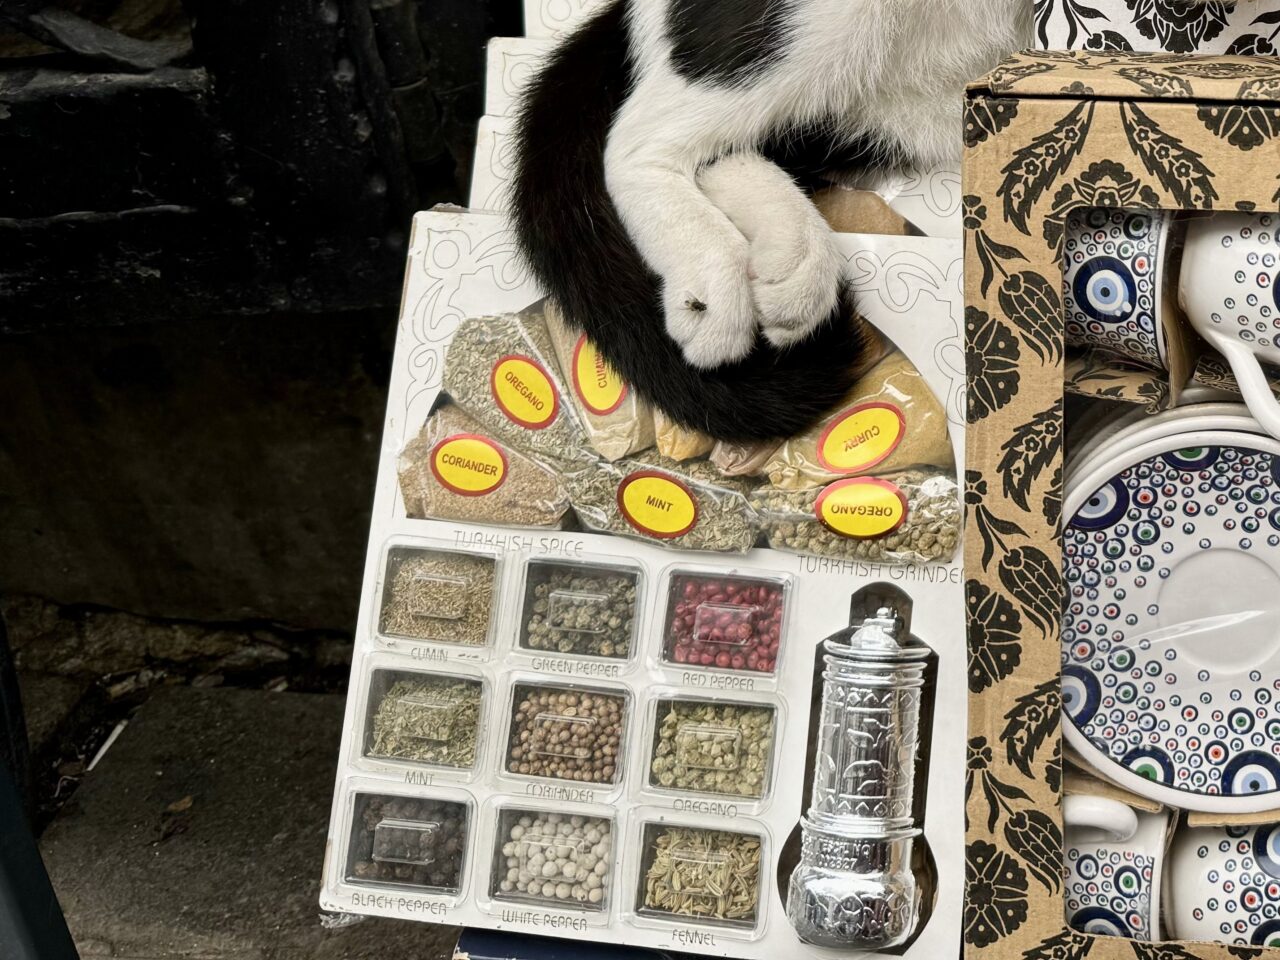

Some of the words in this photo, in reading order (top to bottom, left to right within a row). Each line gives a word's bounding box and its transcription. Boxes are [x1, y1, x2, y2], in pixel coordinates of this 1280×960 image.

[504, 371, 545, 411] OREGANO
[843, 425, 881, 452] CURRY
[441, 453, 498, 477] CORIANDER
[645, 495, 674, 513] MINT
[830, 503, 893, 517] OREGANO
[453, 530, 532, 554] TURKHISH
[539, 538, 584, 558] SPICE
[797, 555, 882, 579] TURKHISH
[410, 647, 449, 662] CUMIN
[531, 657, 573, 674] GREEN
[576, 660, 620, 678] PEPPER
[682, 672, 706, 687] RED
[710, 674, 755, 691] PEPPER
[404, 770, 435, 786] MINT
[525, 783, 595, 804] CORIANDER
[672, 798, 738, 818] OREGANO
[351, 892, 394, 910] BLACK
[397, 895, 448, 916] PEPPER
[502, 908, 541, 926] WHITE
[542, 913, 588, 932] PEPPER
[671, 929, 717, 946] FENNEL
